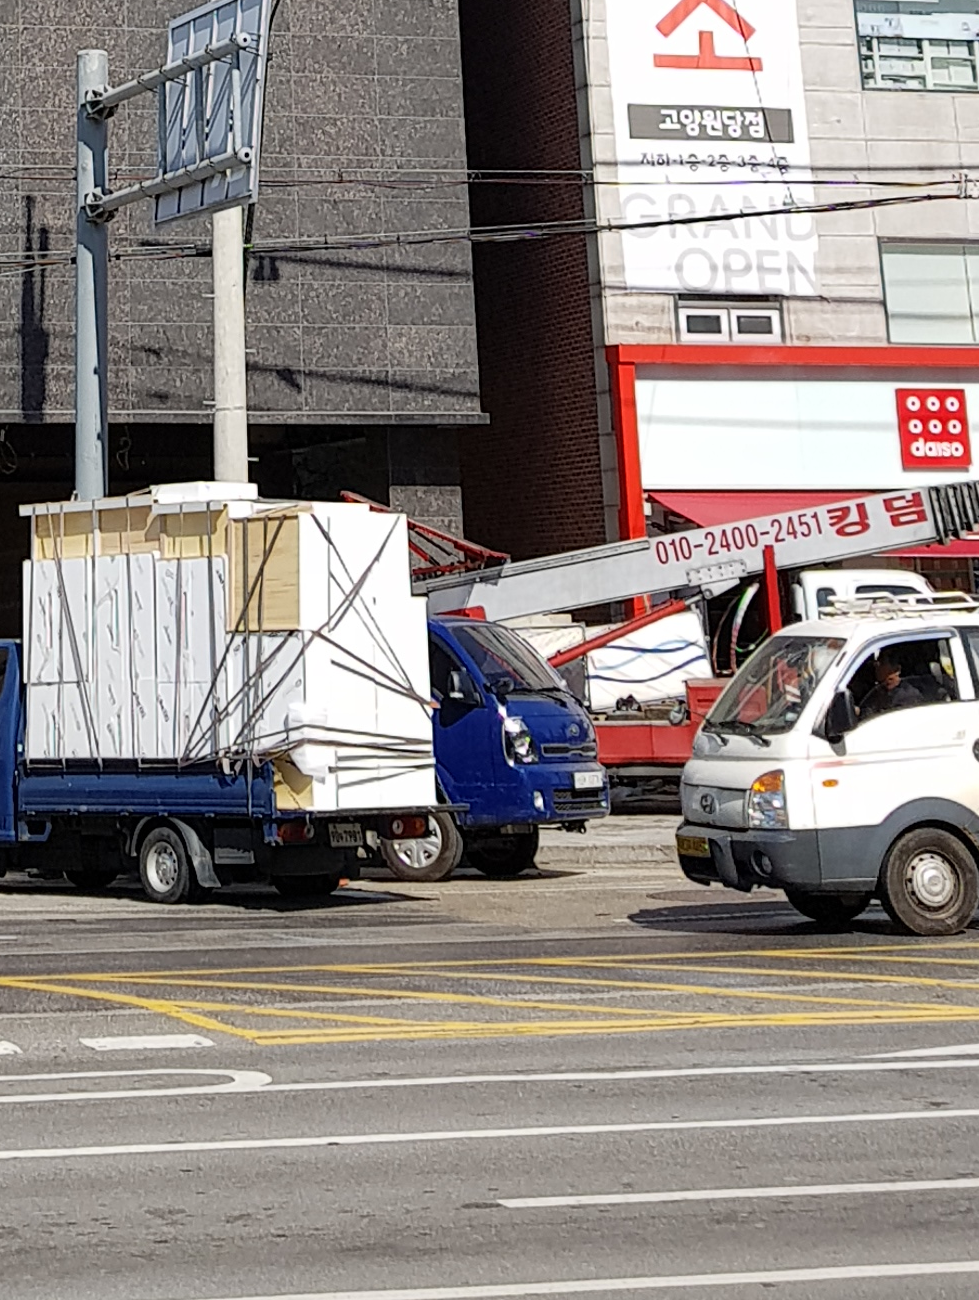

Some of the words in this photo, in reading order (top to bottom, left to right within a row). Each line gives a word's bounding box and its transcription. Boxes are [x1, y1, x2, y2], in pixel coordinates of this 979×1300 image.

[659, 109, 765, 139] 고양원당점
[910, 437, 965, 458] daiso
[655, 511, 823, 566] 010-2400-2451
